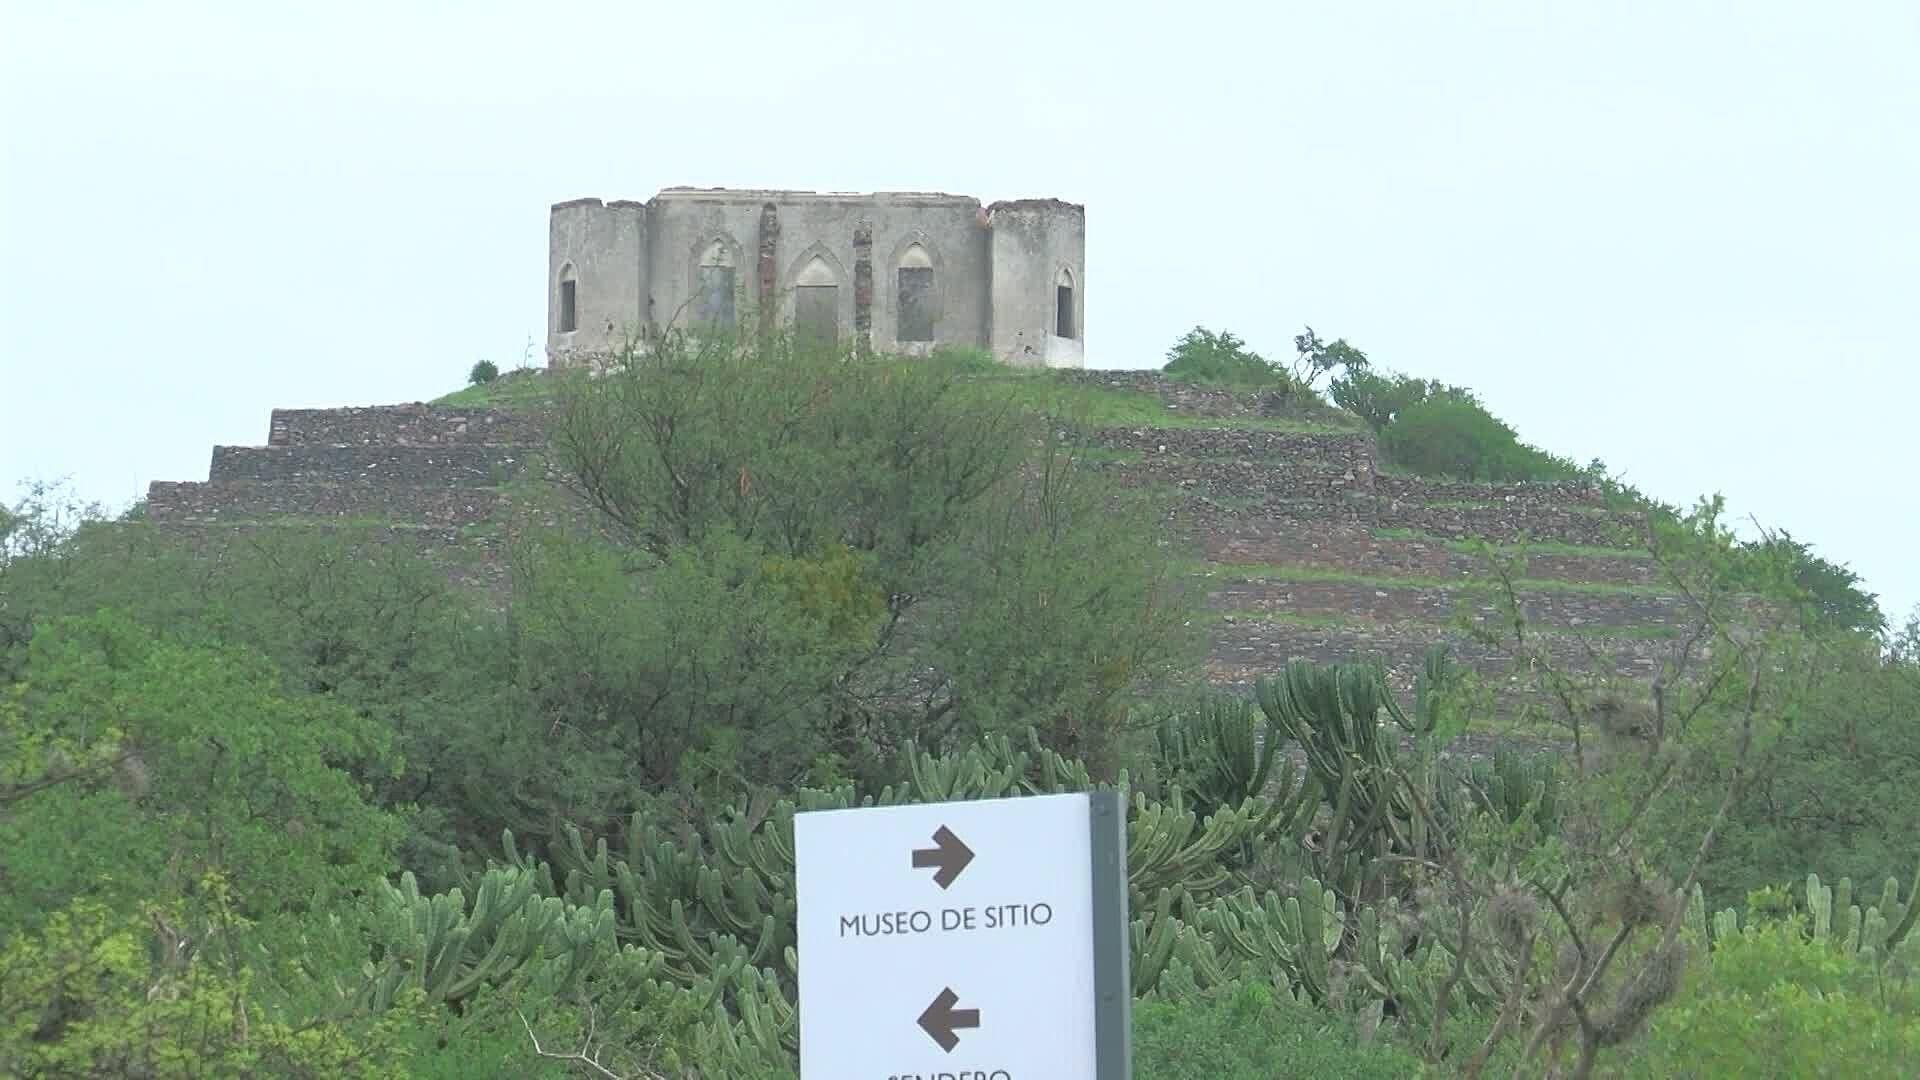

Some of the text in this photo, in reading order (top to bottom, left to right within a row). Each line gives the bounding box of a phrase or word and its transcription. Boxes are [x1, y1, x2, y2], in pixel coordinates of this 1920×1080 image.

[839, 903, 1053, 937] MUSEO DE SITIO
